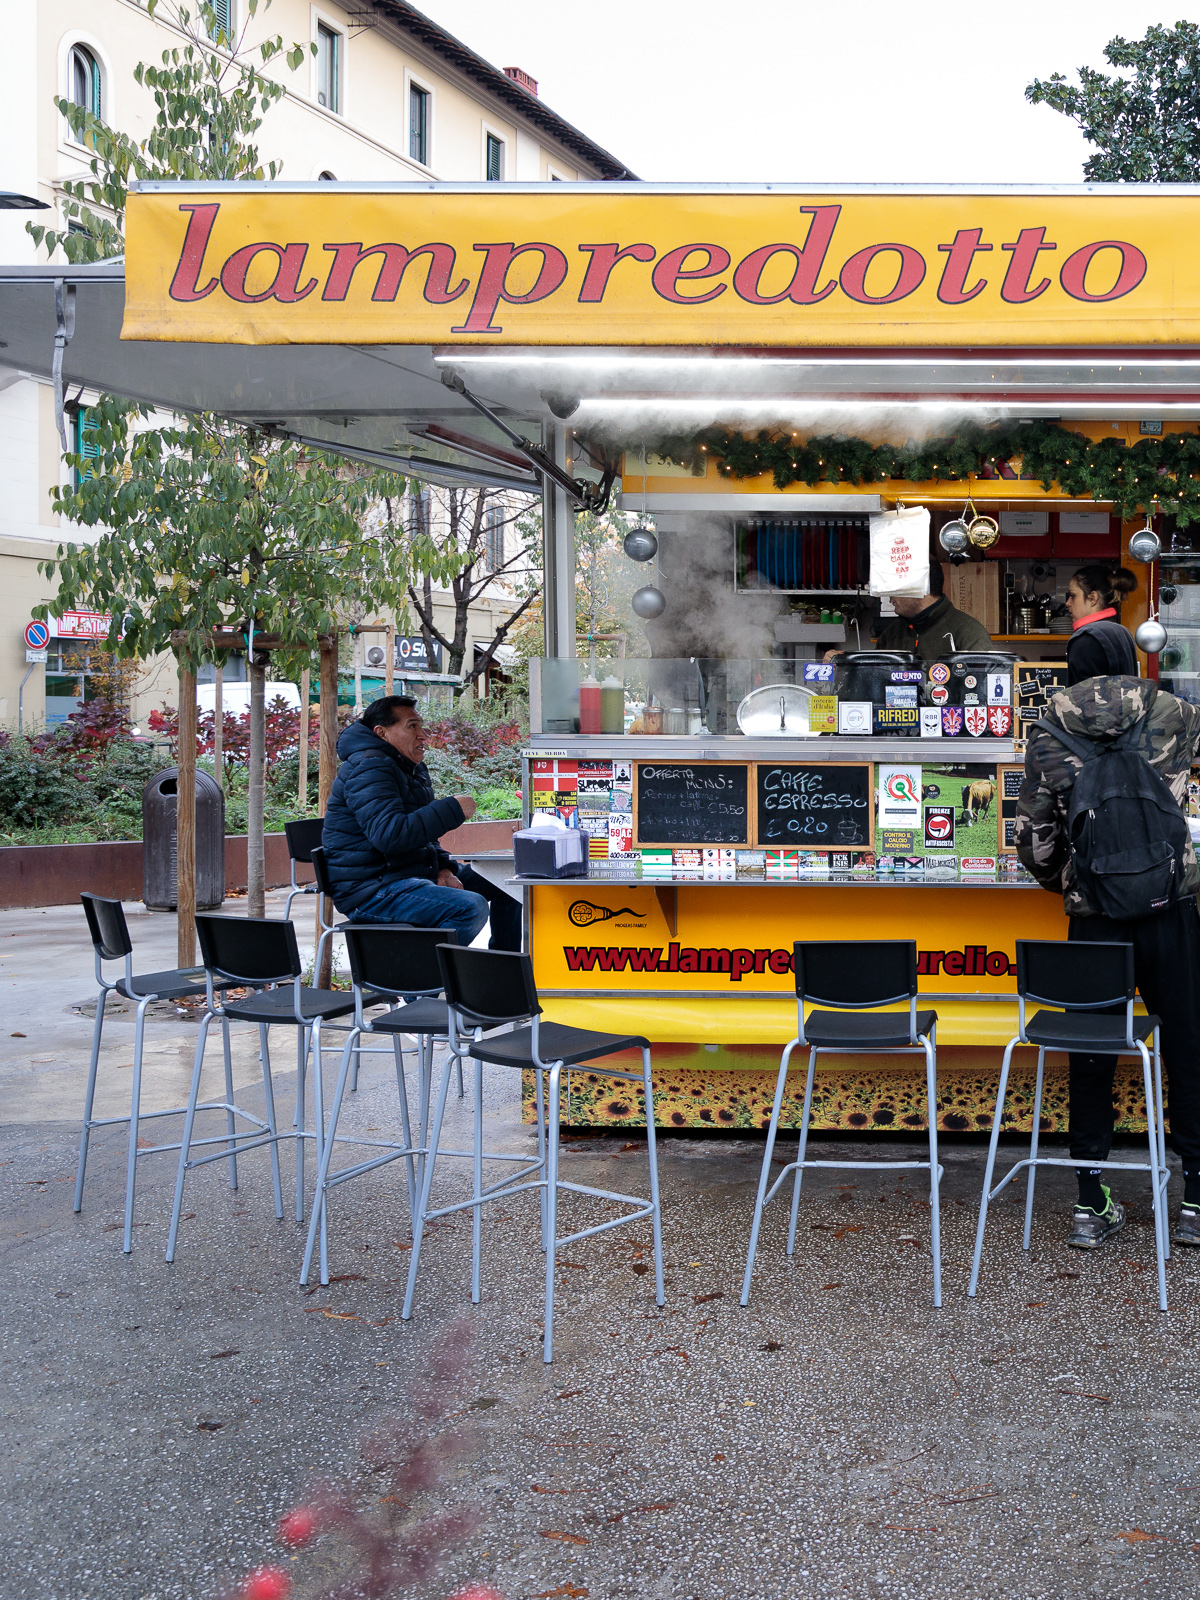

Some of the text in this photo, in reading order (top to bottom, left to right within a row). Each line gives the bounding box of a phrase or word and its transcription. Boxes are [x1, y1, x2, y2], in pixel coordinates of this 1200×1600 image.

[168, 202, 1147, 334] lampredotto
[878, 709, 919, 722] RIFREDI
[577, 779, 614, 790] SUPPORT
[764, 792, 868, 810] ESPRESSO
[765, 819, 782, 838] €
[786, 816, 828, 834] 0,20
